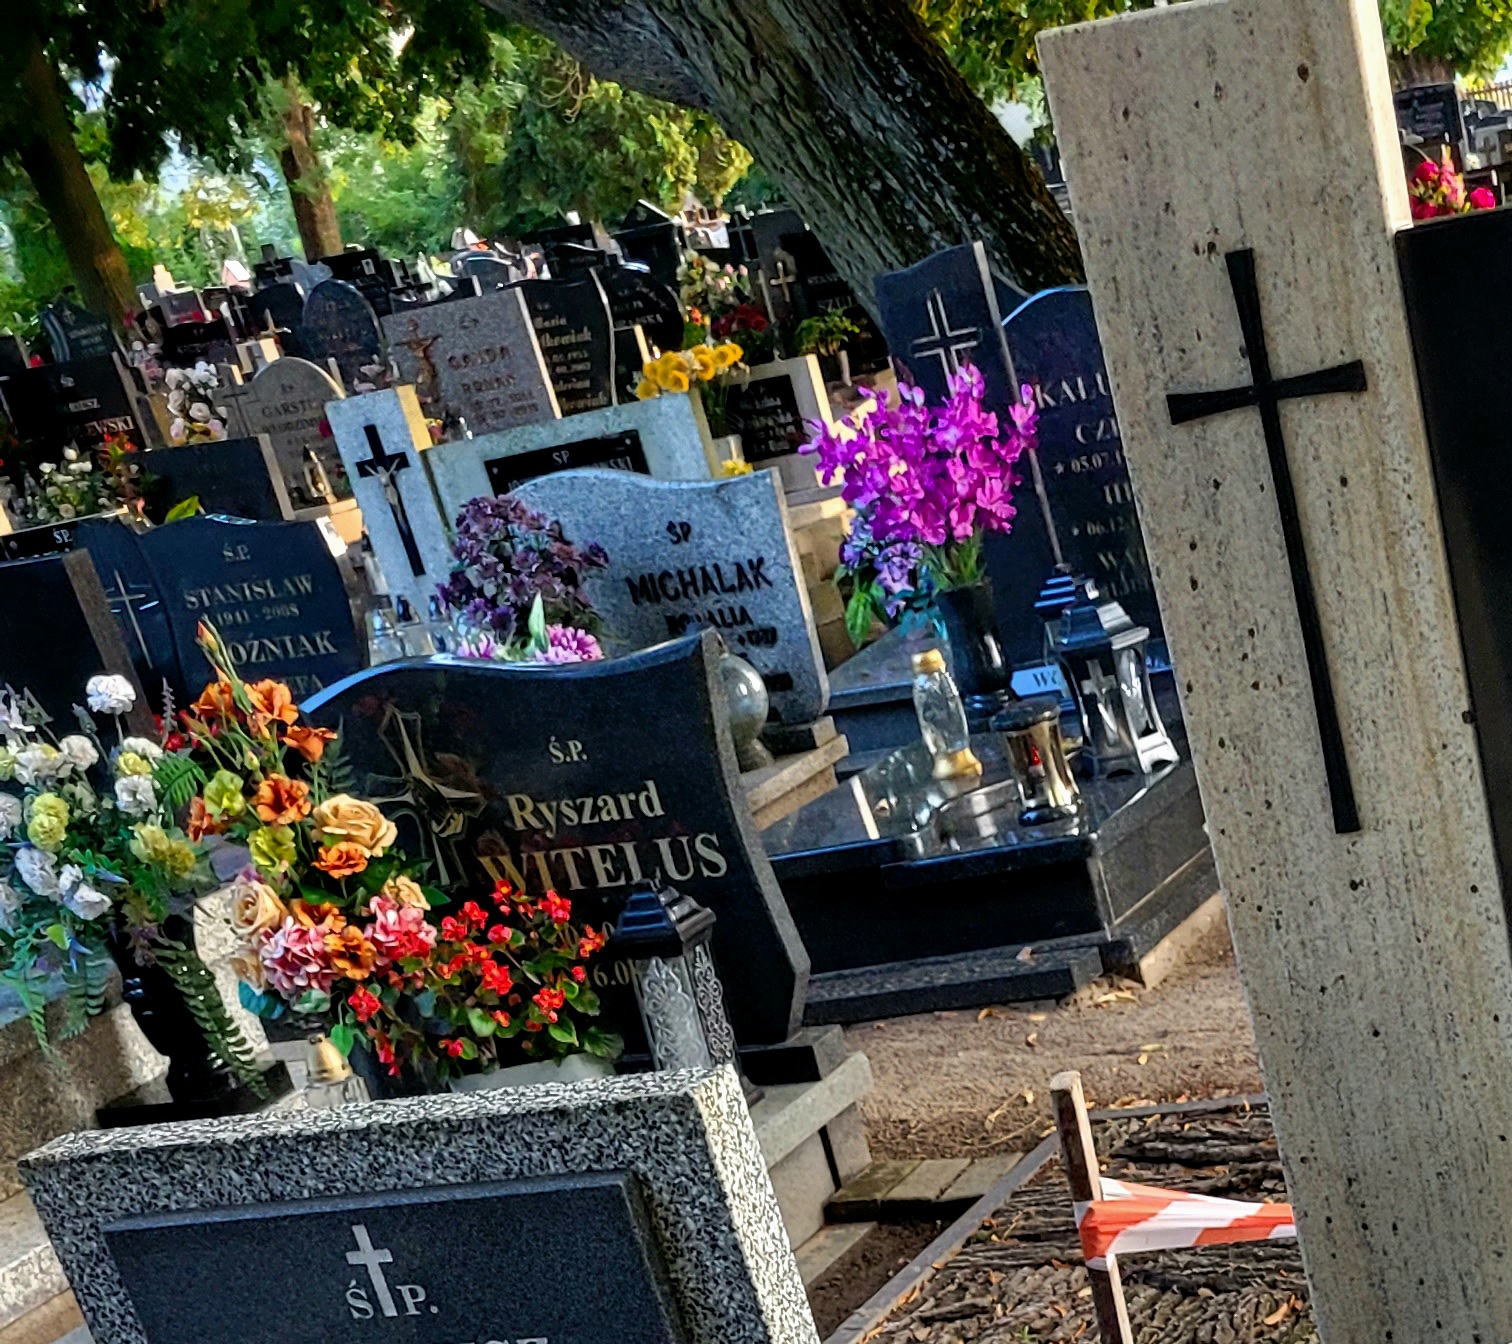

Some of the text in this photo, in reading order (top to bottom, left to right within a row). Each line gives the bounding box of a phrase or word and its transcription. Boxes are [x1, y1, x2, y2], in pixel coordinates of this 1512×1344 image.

[625, 557, 773, 606] MICHALAK
[227, 631, 339, 665] OŹNIAK
[548, 735, 588, 764] Ś.P.
[504, 780, 666, 838] Ryszard
[478, 830, 729, 892] WITELUS
